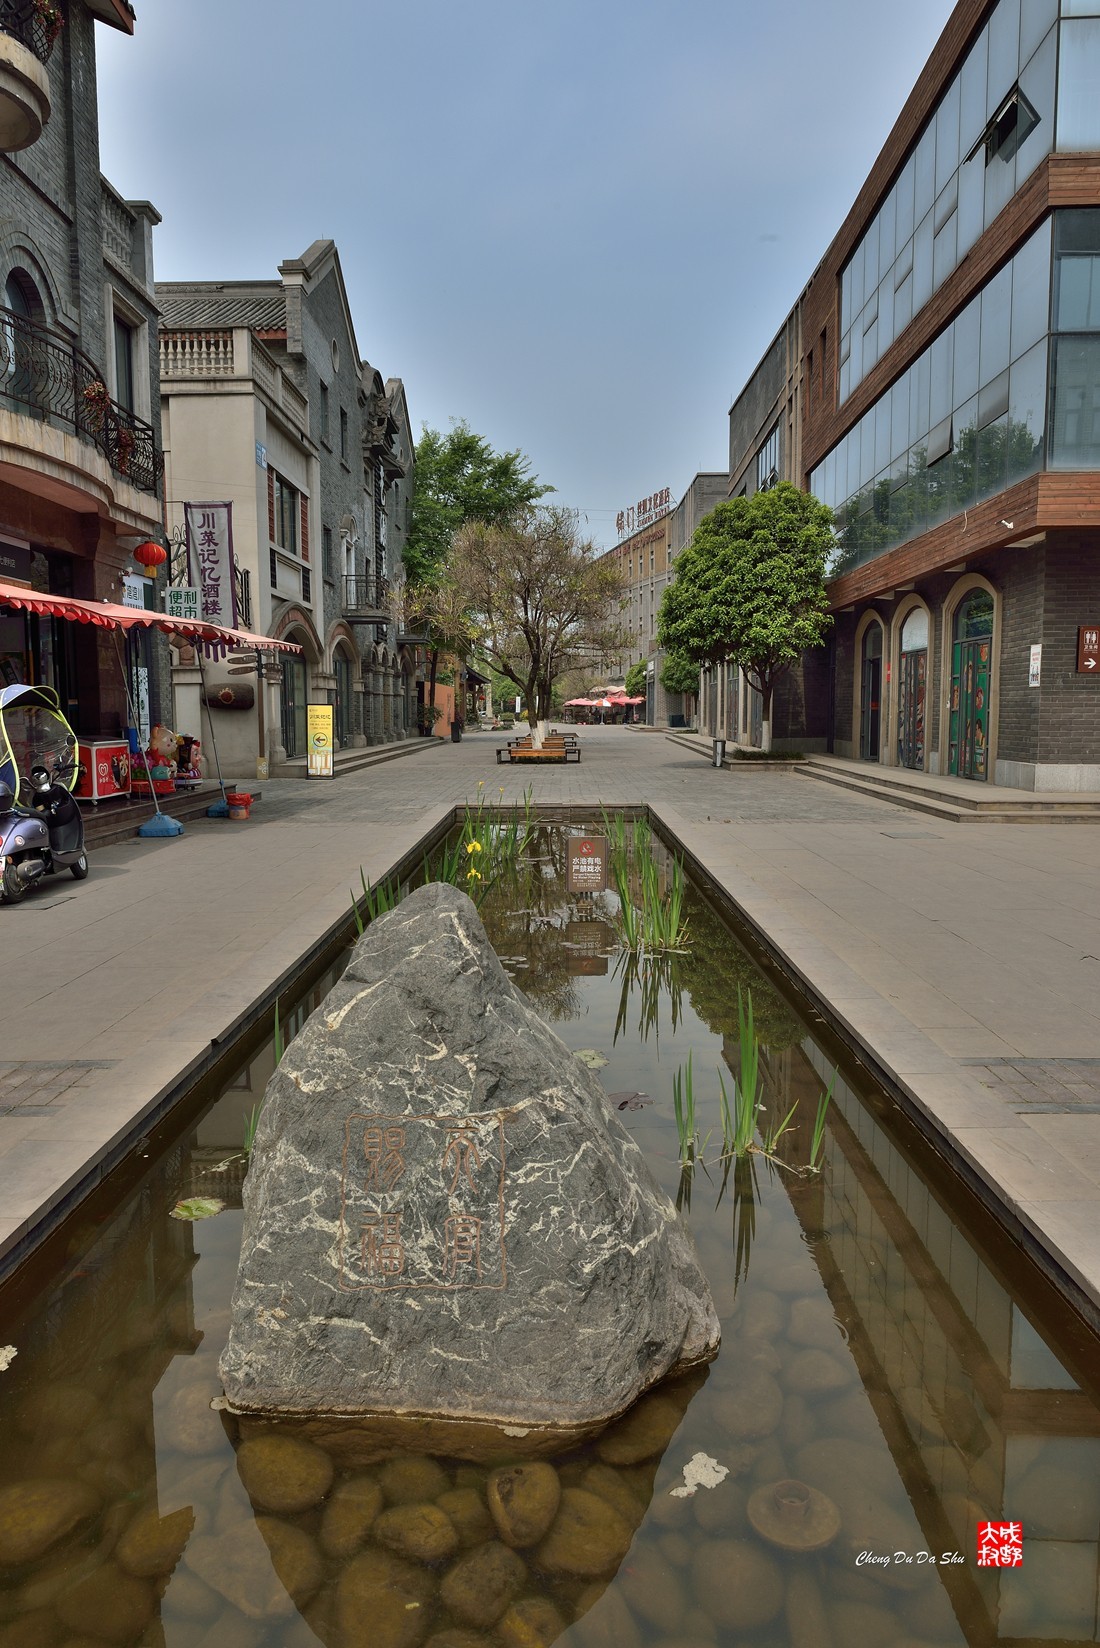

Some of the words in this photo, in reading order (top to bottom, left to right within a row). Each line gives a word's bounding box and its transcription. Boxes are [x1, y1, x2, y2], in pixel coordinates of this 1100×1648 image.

[197, 512, 222, 616] 川菜记忆酒楼
[169, 591, 197, 604] 便利
[169, 606, 197, 618] 超市
[572, 857, 602, 865] 水池有电
[572, 865, 602, 873] 严禁戏水
